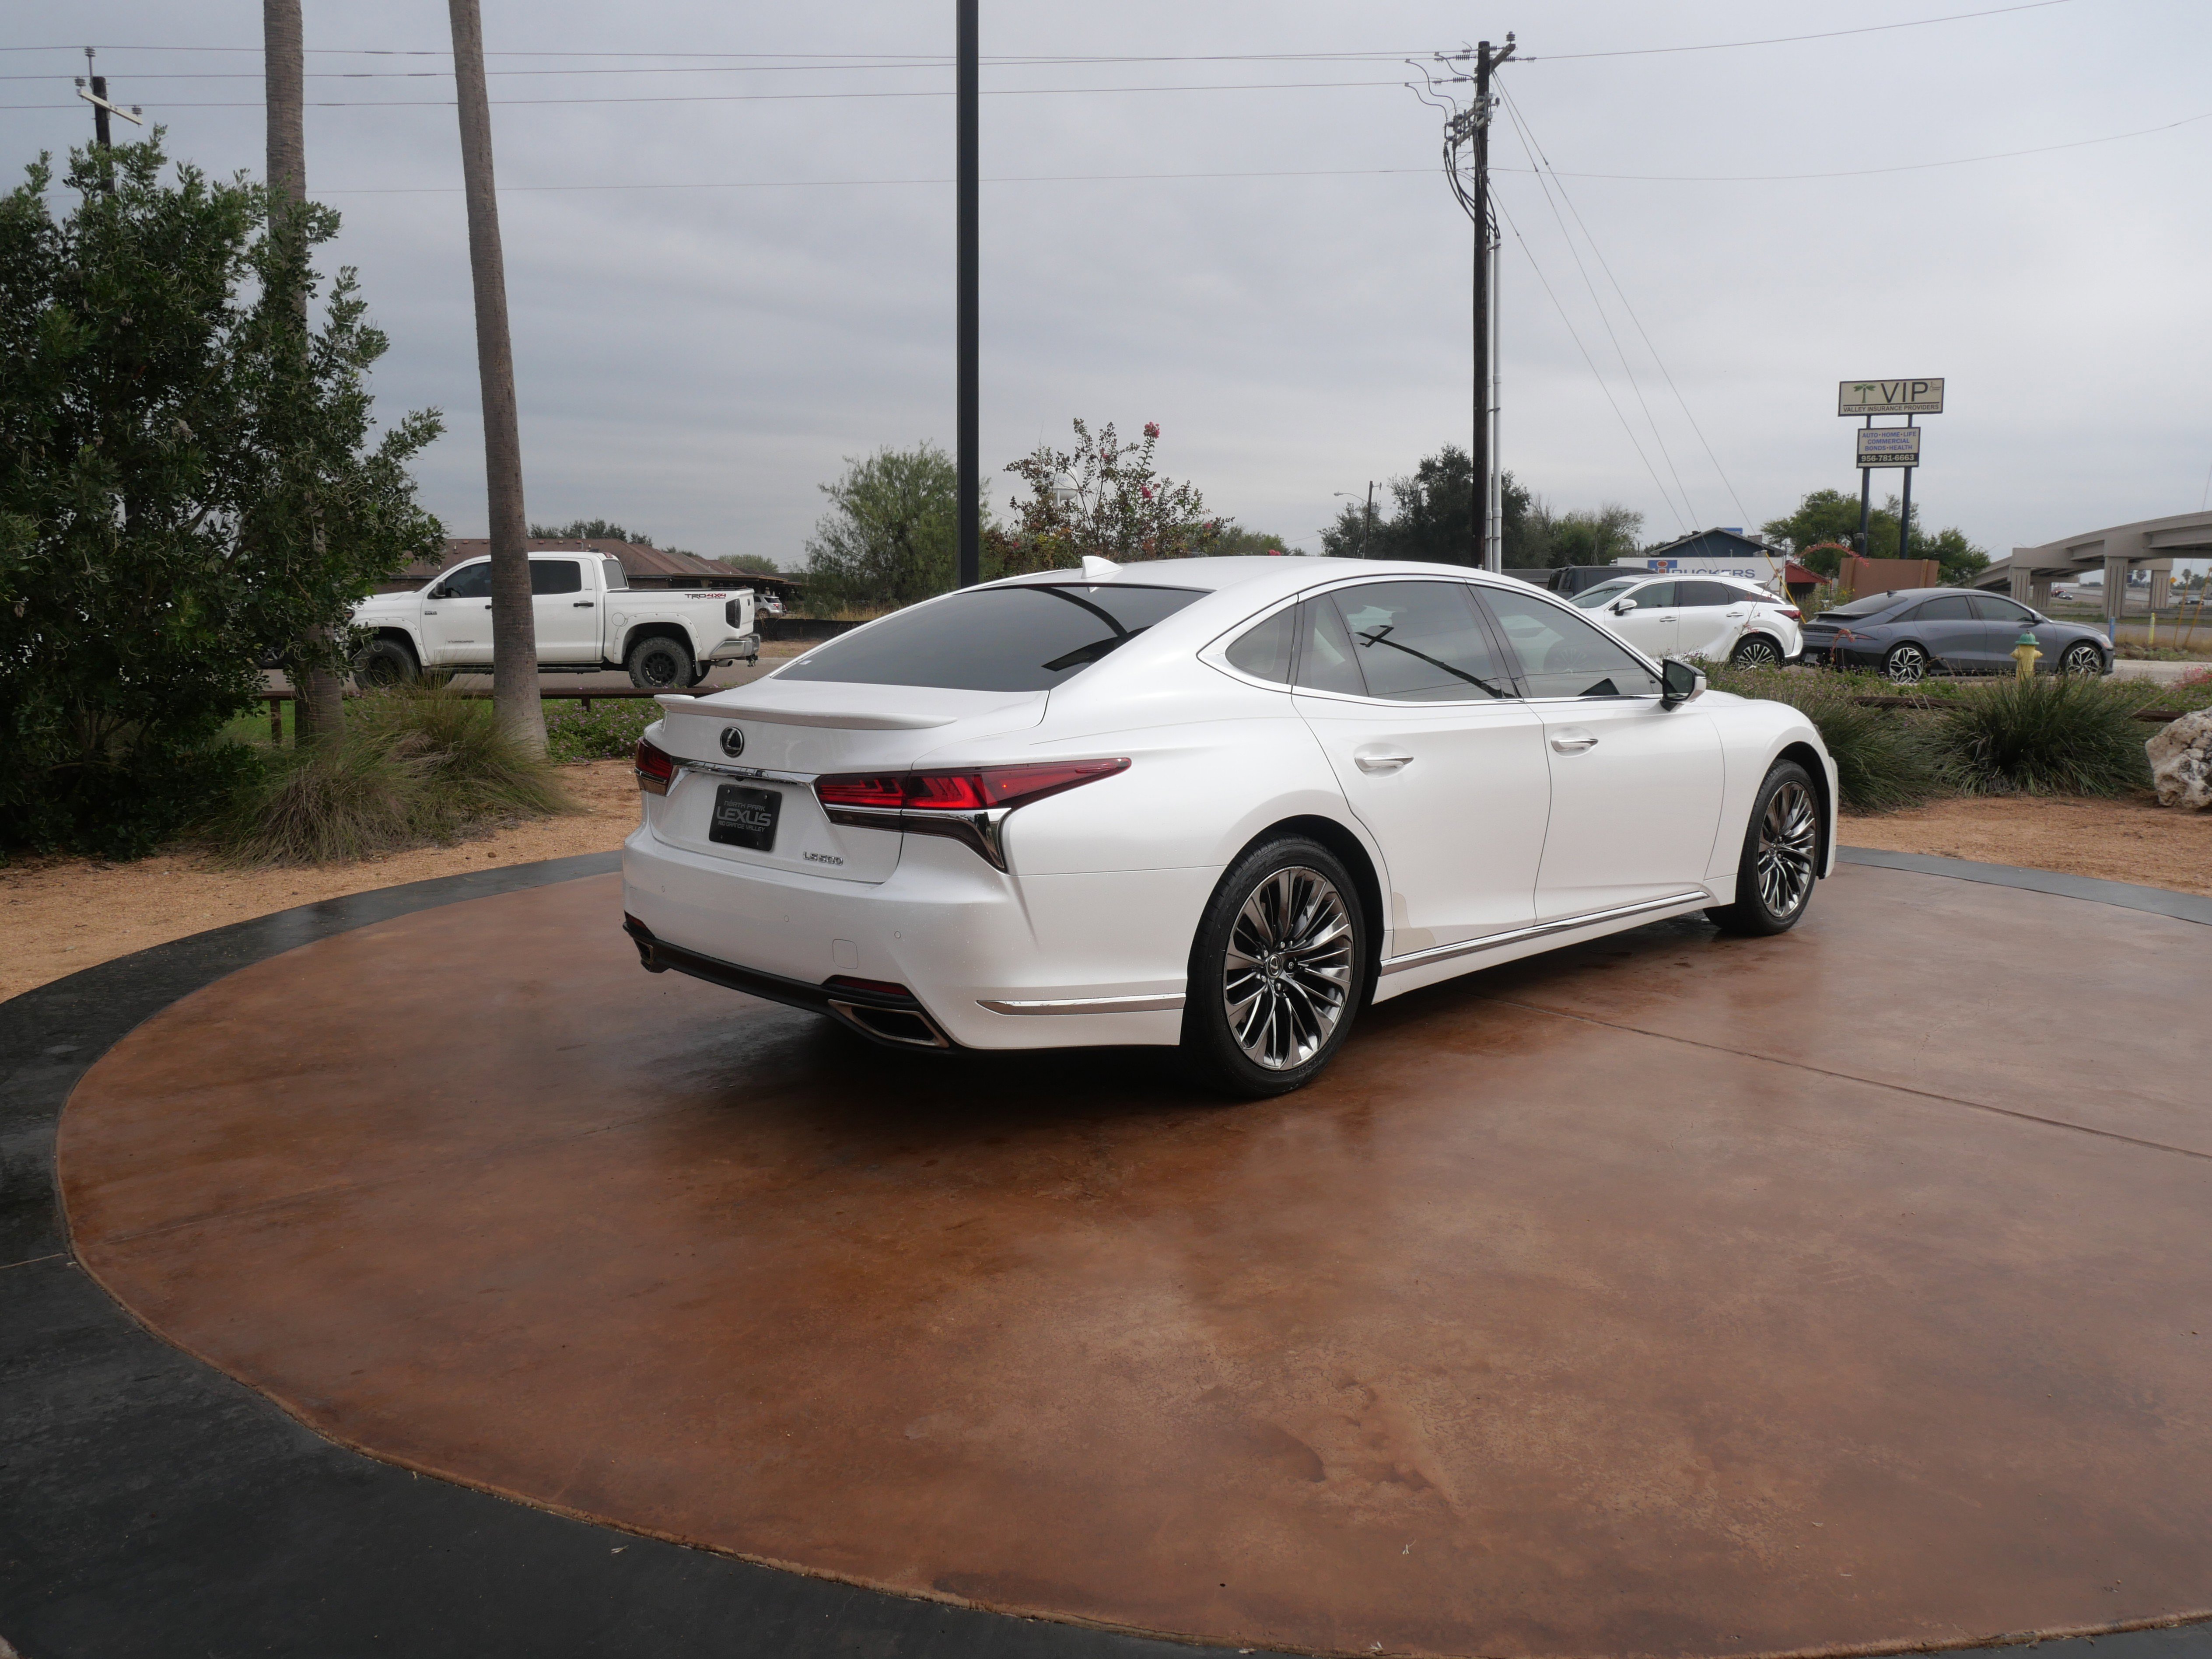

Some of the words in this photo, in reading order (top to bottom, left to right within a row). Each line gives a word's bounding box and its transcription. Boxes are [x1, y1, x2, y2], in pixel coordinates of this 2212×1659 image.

[1881, 382, 1928, 403] VIP
[747, 803, 766, 812] PARK
[716, 805, 772, 827] LEXUS
[726, 821, 745, 829] GRANDE
[802, 851, 818, 861] LS
[818, 854, 844, 866] 500
